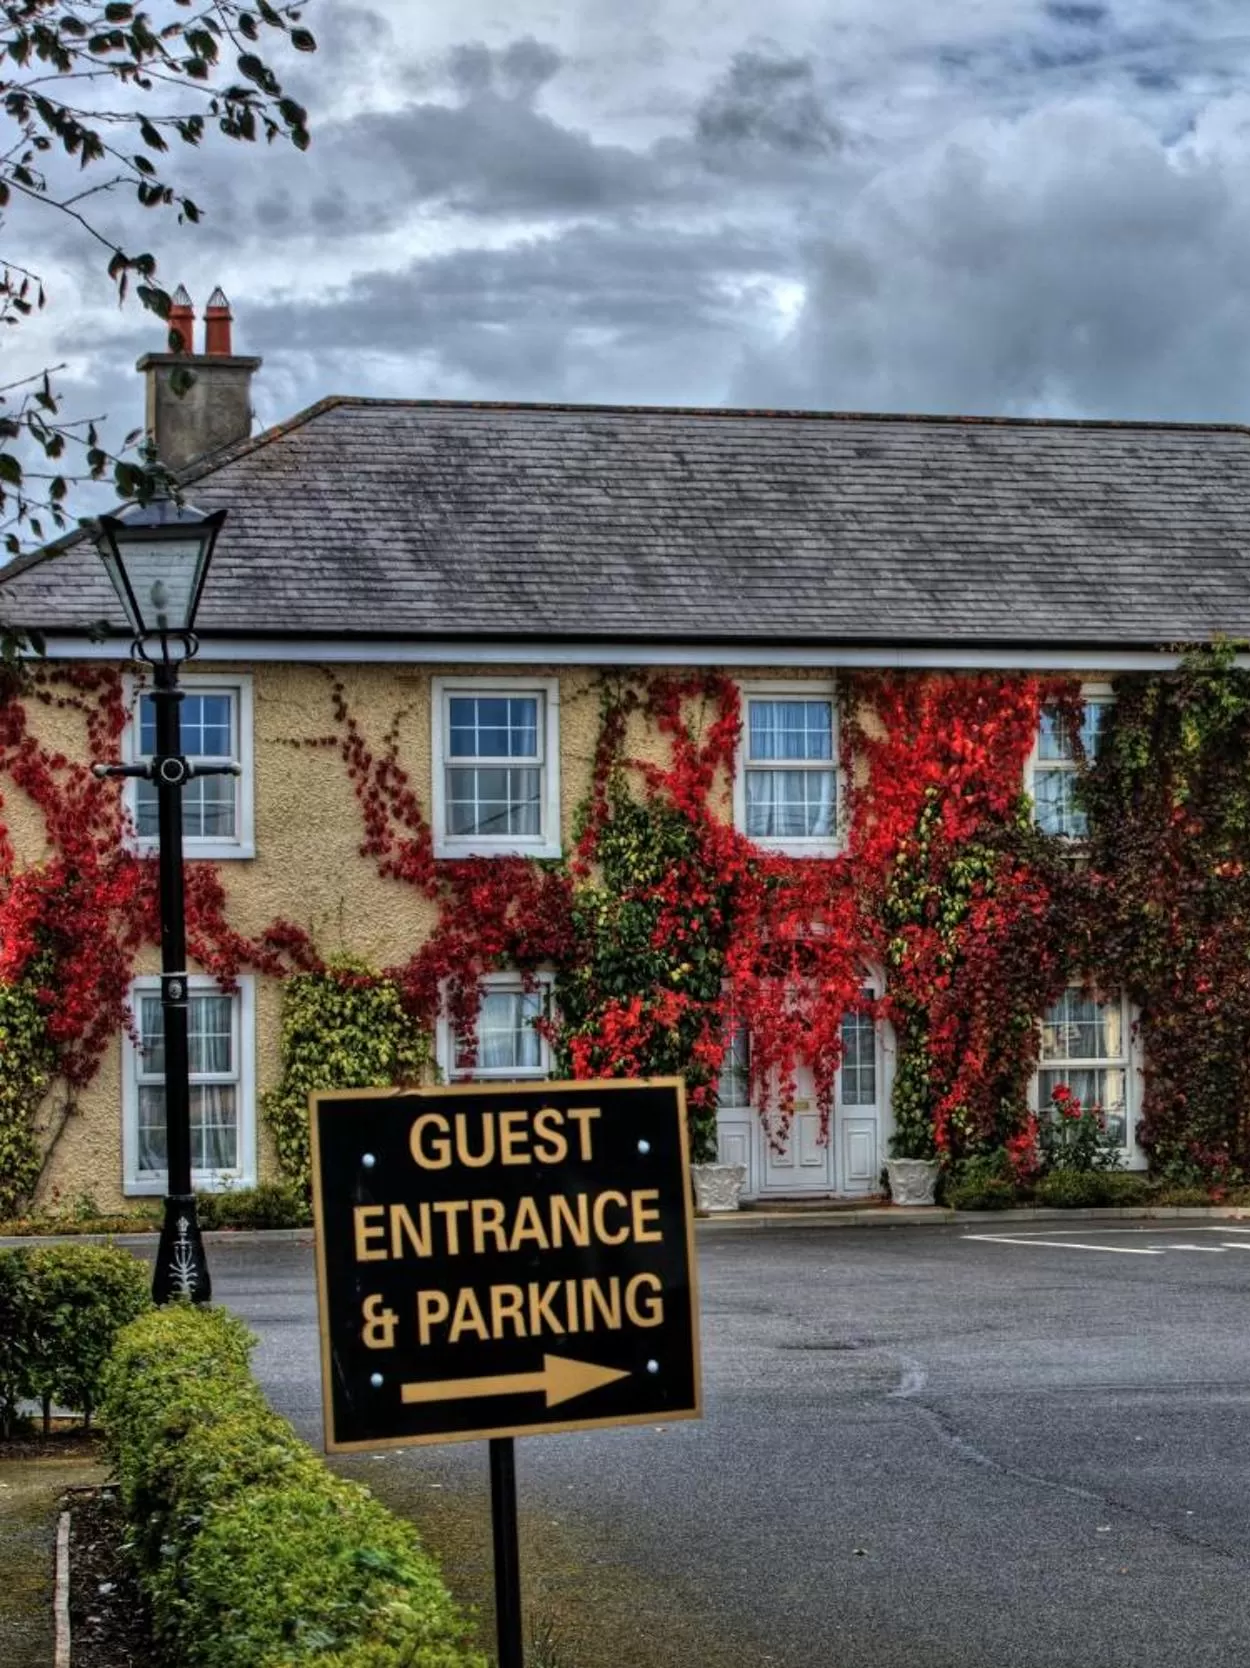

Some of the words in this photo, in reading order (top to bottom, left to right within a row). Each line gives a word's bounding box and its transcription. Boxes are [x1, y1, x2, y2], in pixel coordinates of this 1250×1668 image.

[409, 1108, 602, 1170] GUEST
[353, 1189, 664, 1263] ENTRANCE
[361, 1294, 399, 1350] &
[416, 1272, 665, 1346] PARKING
